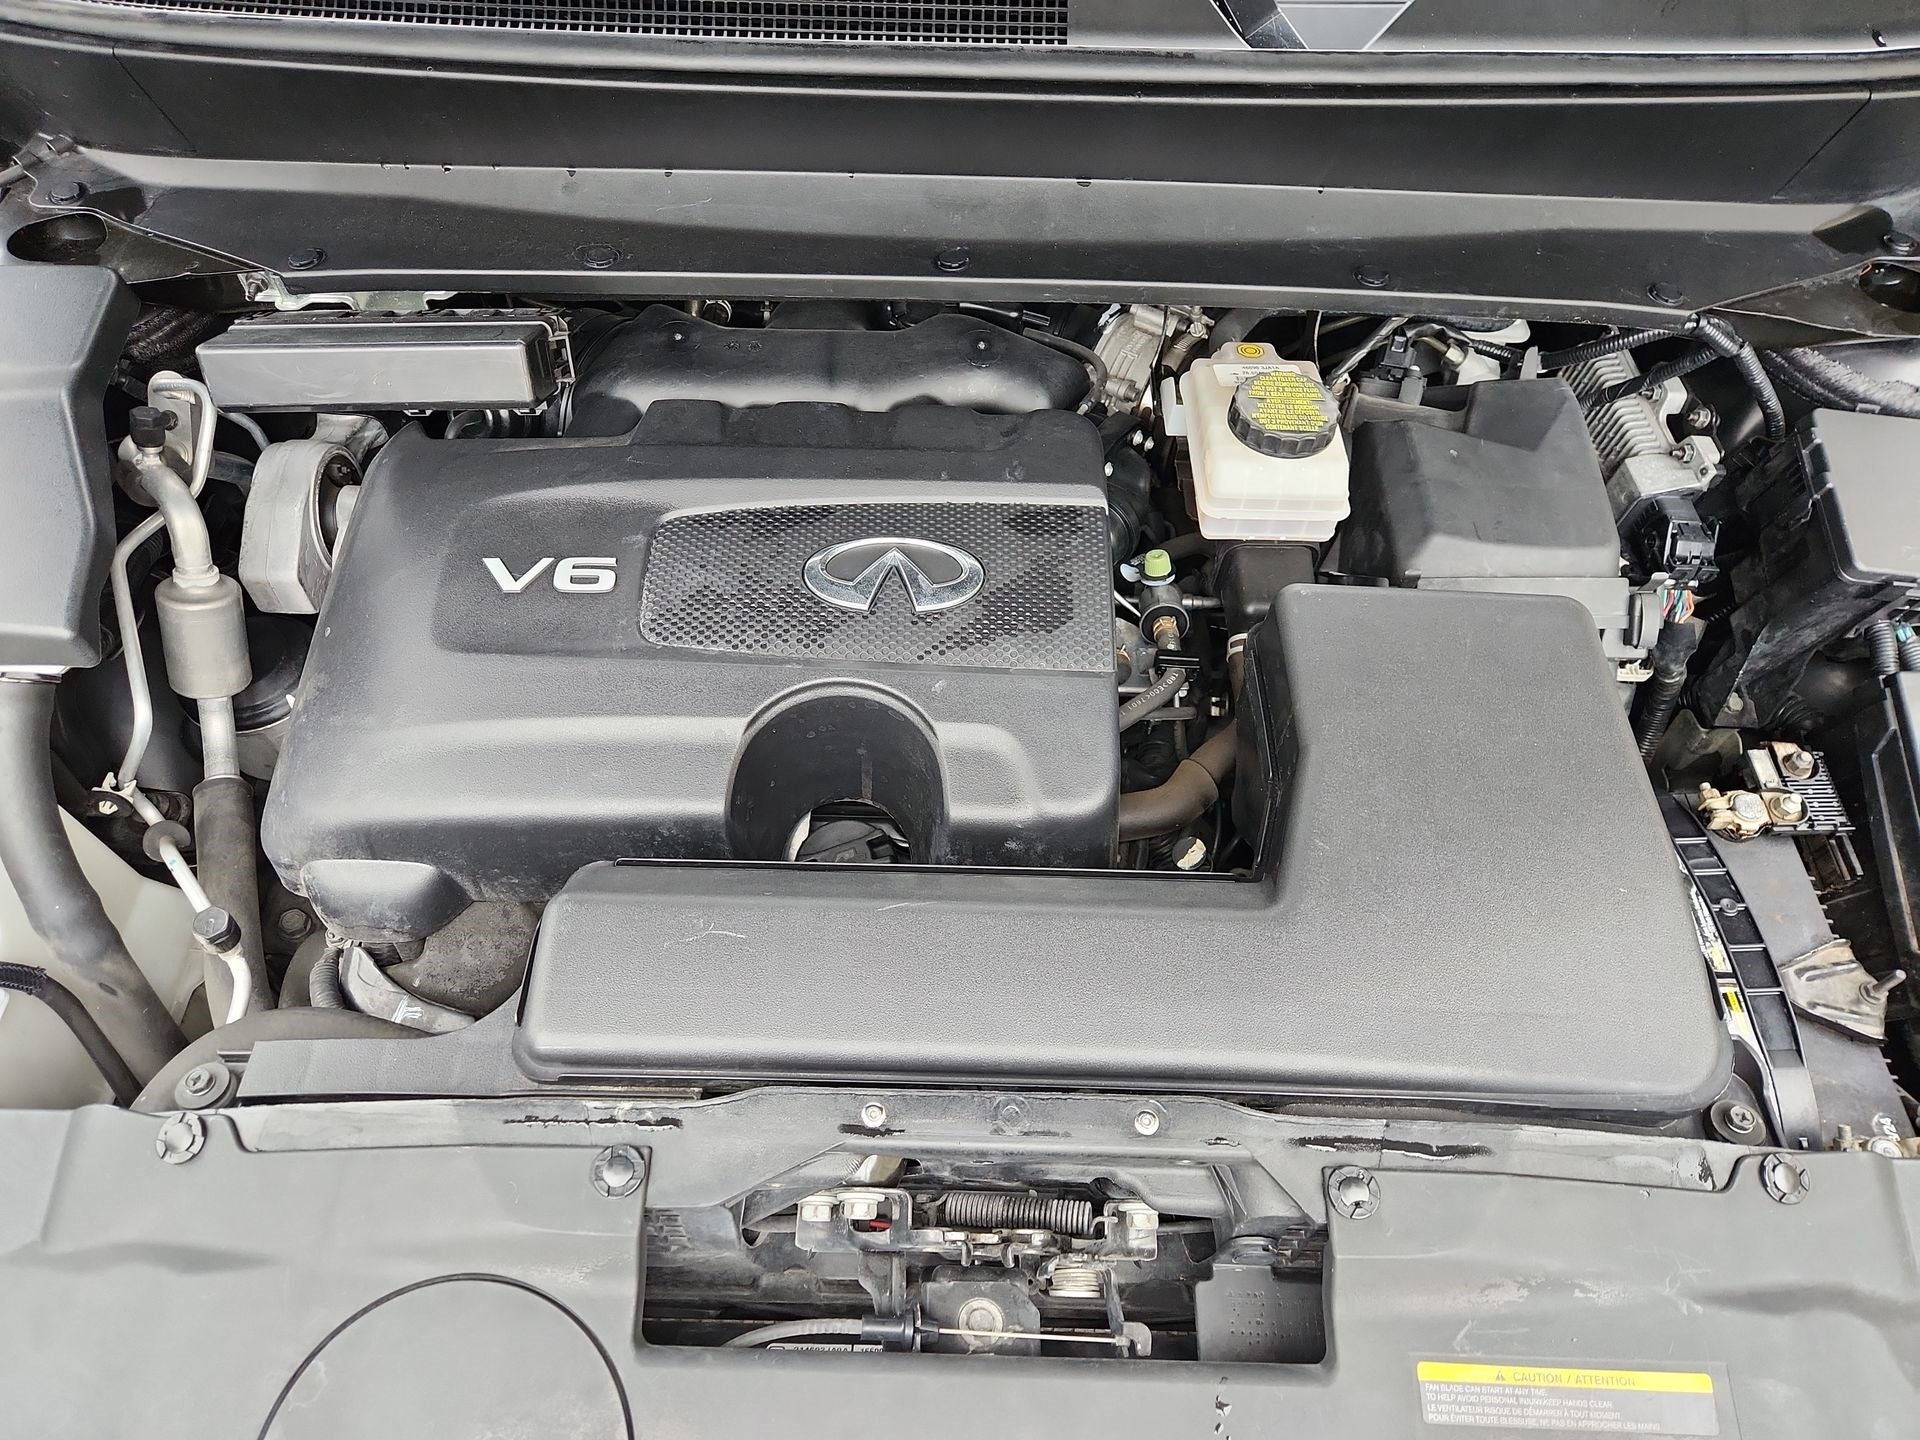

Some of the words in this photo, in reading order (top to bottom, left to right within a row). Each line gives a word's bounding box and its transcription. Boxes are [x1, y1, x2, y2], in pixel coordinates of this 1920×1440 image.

[482, 556, 618, 594] V6
[1512, 1372, 1562, 1384] CAUTION
[1575, 1375, 1636, 1386] ATTENTION
[1425, 1383, 1440, 1392] FAN
[1440, 1384, 1464, 1393] BLADE
[1464, 1384, 1481, 1393] CAN
[1481, 1385, 1503, 1394] START
[1515, 1387, 1530, 1395] ANY
[1426, 1392, 1437, 1401] TO
[1438, 1393, 1456, 1402] HELP
[1457, 1394, 1479, 1403] AVOID
[1480, 1395, 1518, 1404] PERSONAL
[1543, 1398, 1562, 1406] KEEP
[1563, 1399, 1588, 1408] HANDS
[1427, 1404, 1436, 1412] LE
[1437, 1404, 1483, 1413] VENTILATEUR
[1484, 1406, 1511, 1415] RISQUE
[1523, 1406, 1562, 1417] DÉMARRER
[1570, 1410, 1589, 1418] TOUT
[1428, 1412, 1449, 1422] POUR
[1476, 1415, 1499, 1424] TOUTE
[1551, 1419, 1566, 1427] PAS
[1566, 1419, 1577, 1427] EN
[1578, 1420, 1622, 1429] APPROCHER
[1623, 1422, 1636, 1430] LES
